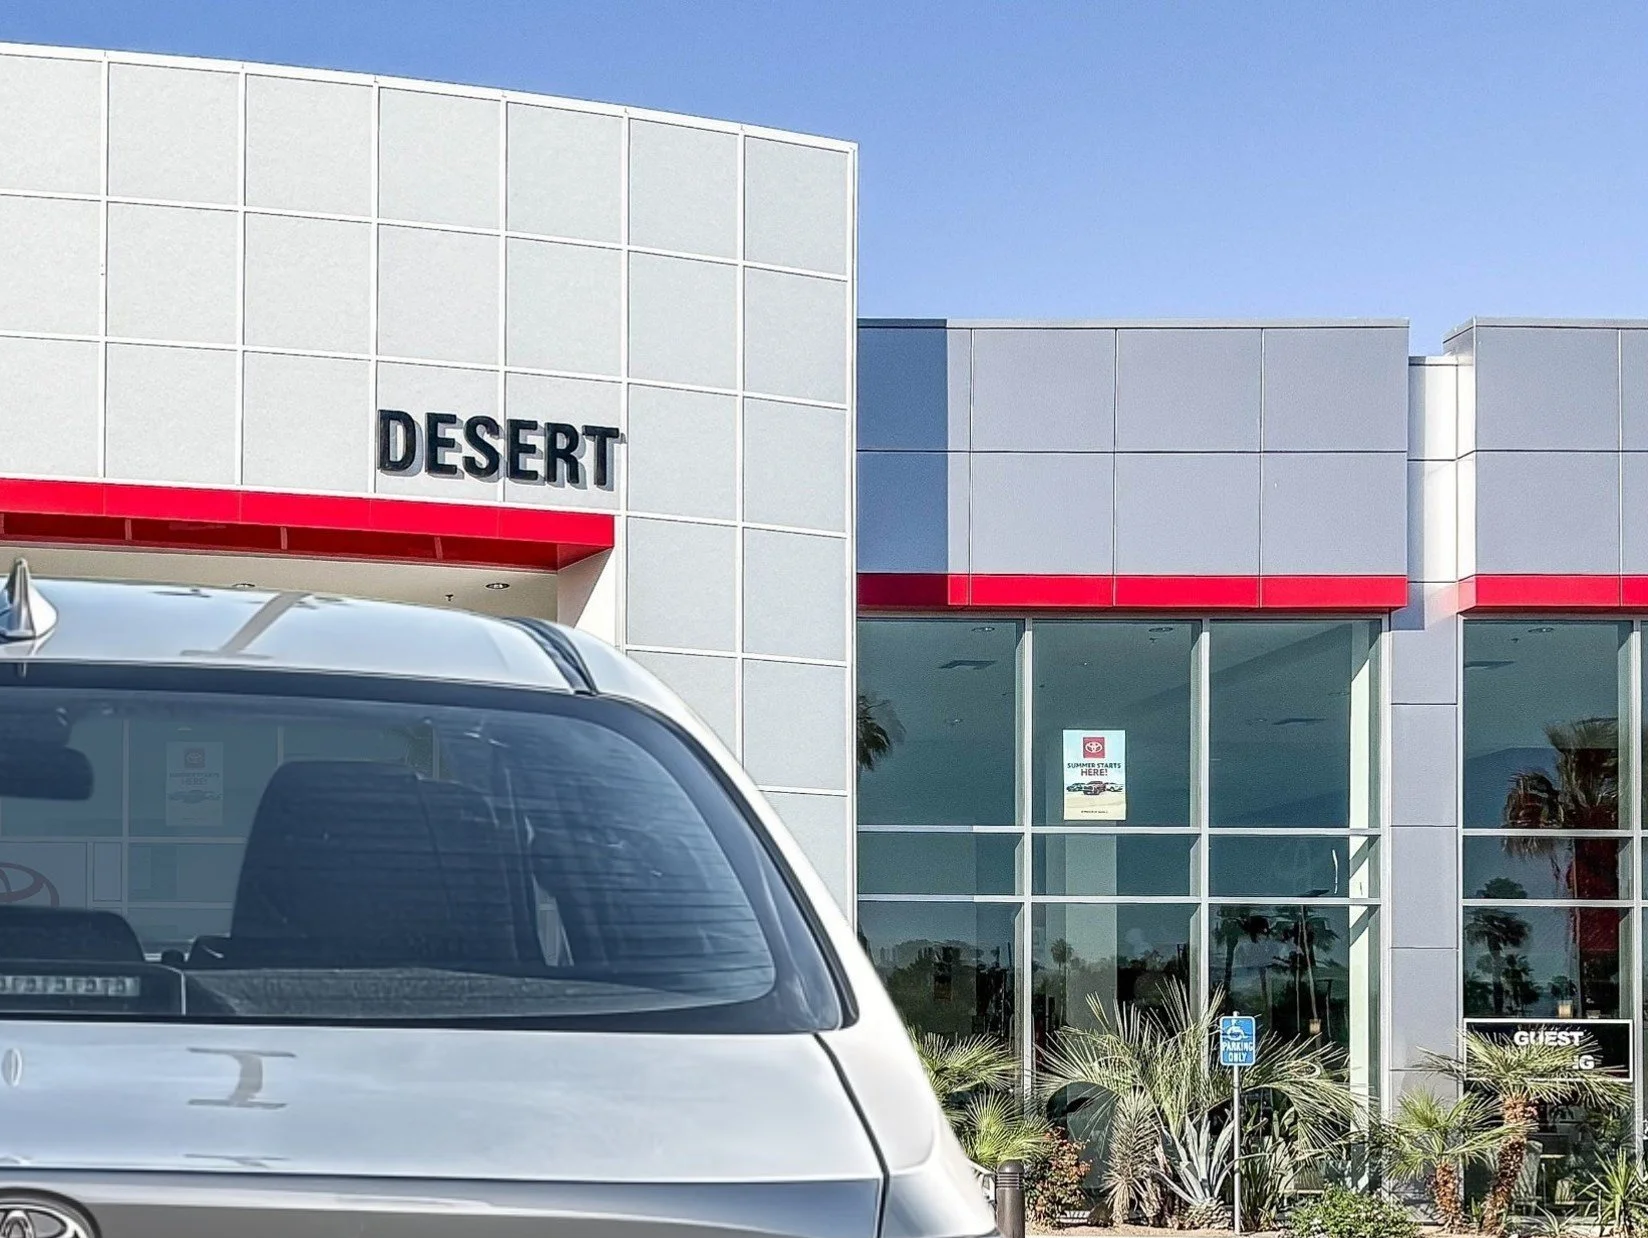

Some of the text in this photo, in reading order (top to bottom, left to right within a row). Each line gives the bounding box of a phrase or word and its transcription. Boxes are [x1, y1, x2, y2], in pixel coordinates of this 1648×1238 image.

[377, 409, 620, 487] DESERT
[1513, 1031, 1584, 1047] GUEST
[1222, 1041, 1254, 1051] PARKING
[1228, 1052, 1247, 1062] ONLY
